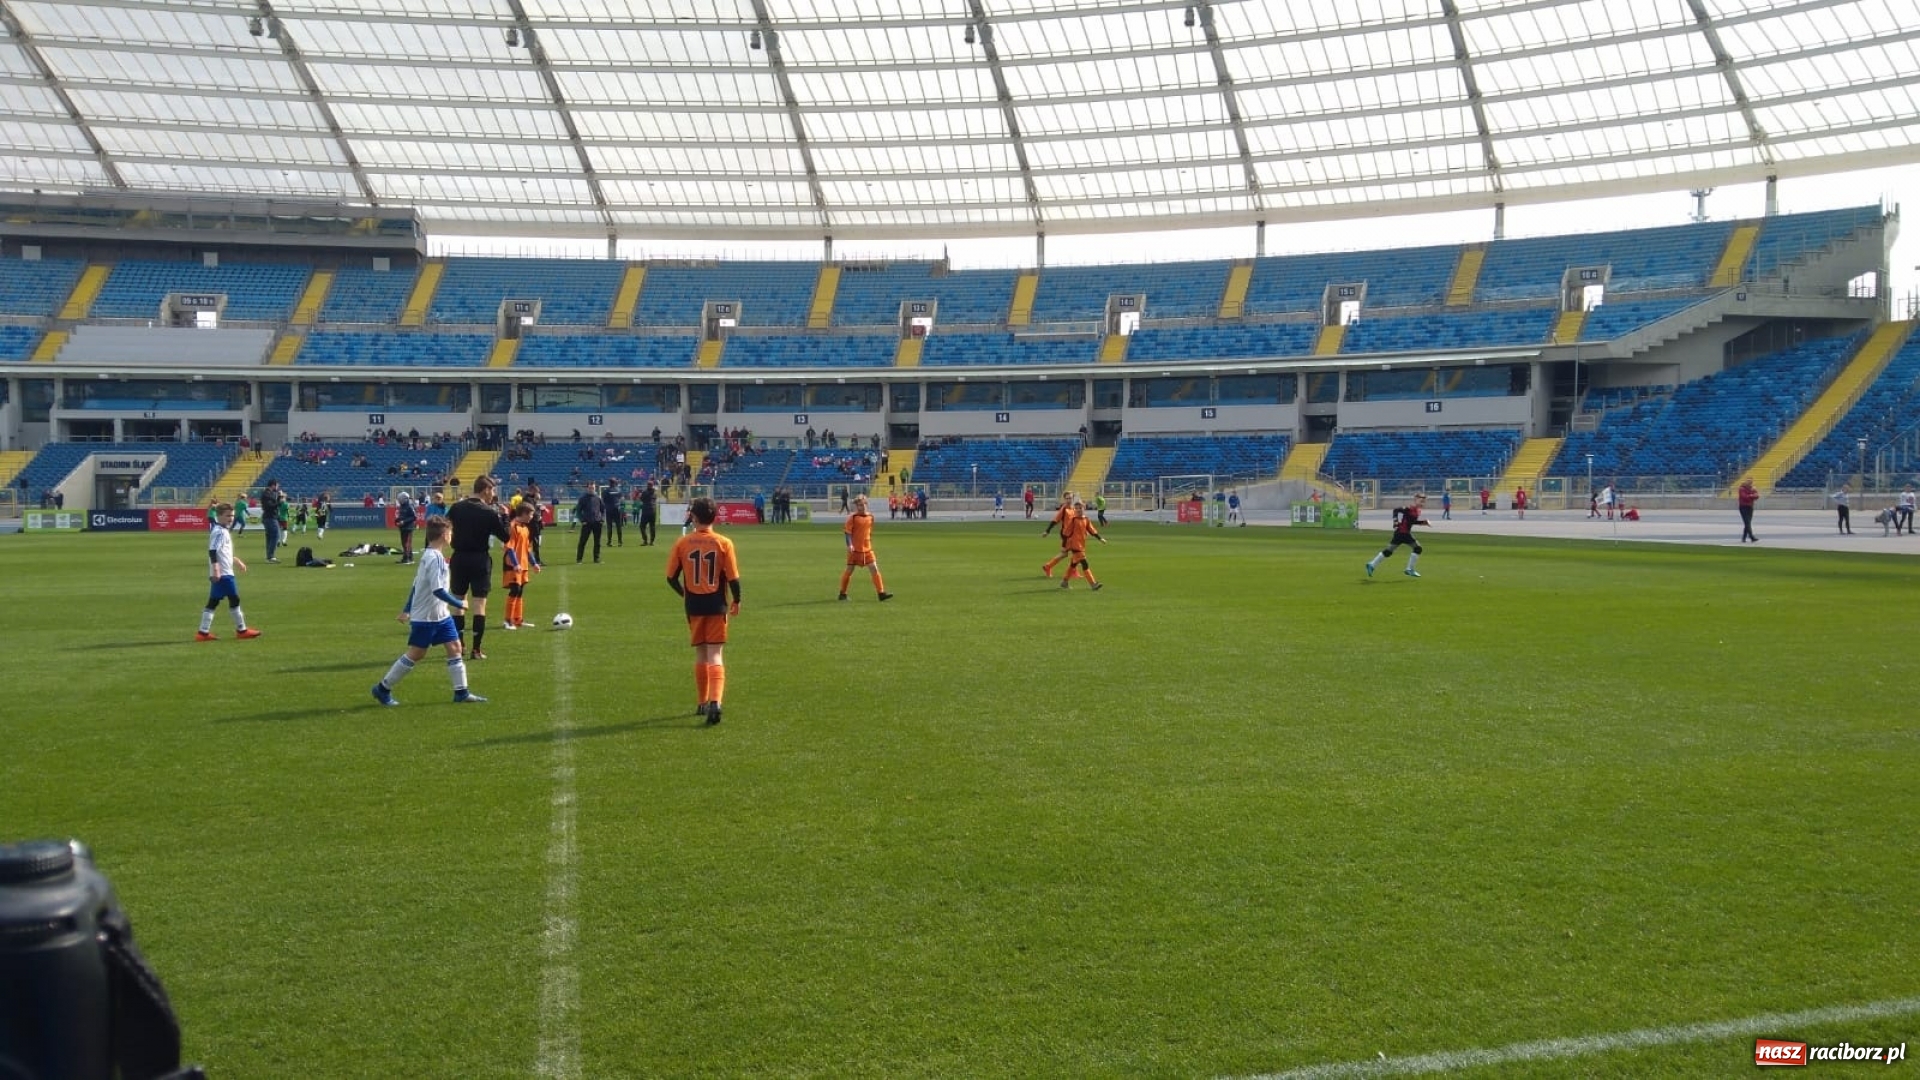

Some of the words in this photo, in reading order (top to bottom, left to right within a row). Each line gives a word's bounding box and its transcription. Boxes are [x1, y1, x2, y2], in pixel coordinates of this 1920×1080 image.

[1430, 402, 1439, 411] 16
[1205, 409, 1214, 417] 15
[372, 415, 381, 423] 11
[592, 416, 601, 424] 12
[998, 414, 1007, 422] 14
[100, 460, 130, 468] STADION
[688, 549, 716, 586] 11
